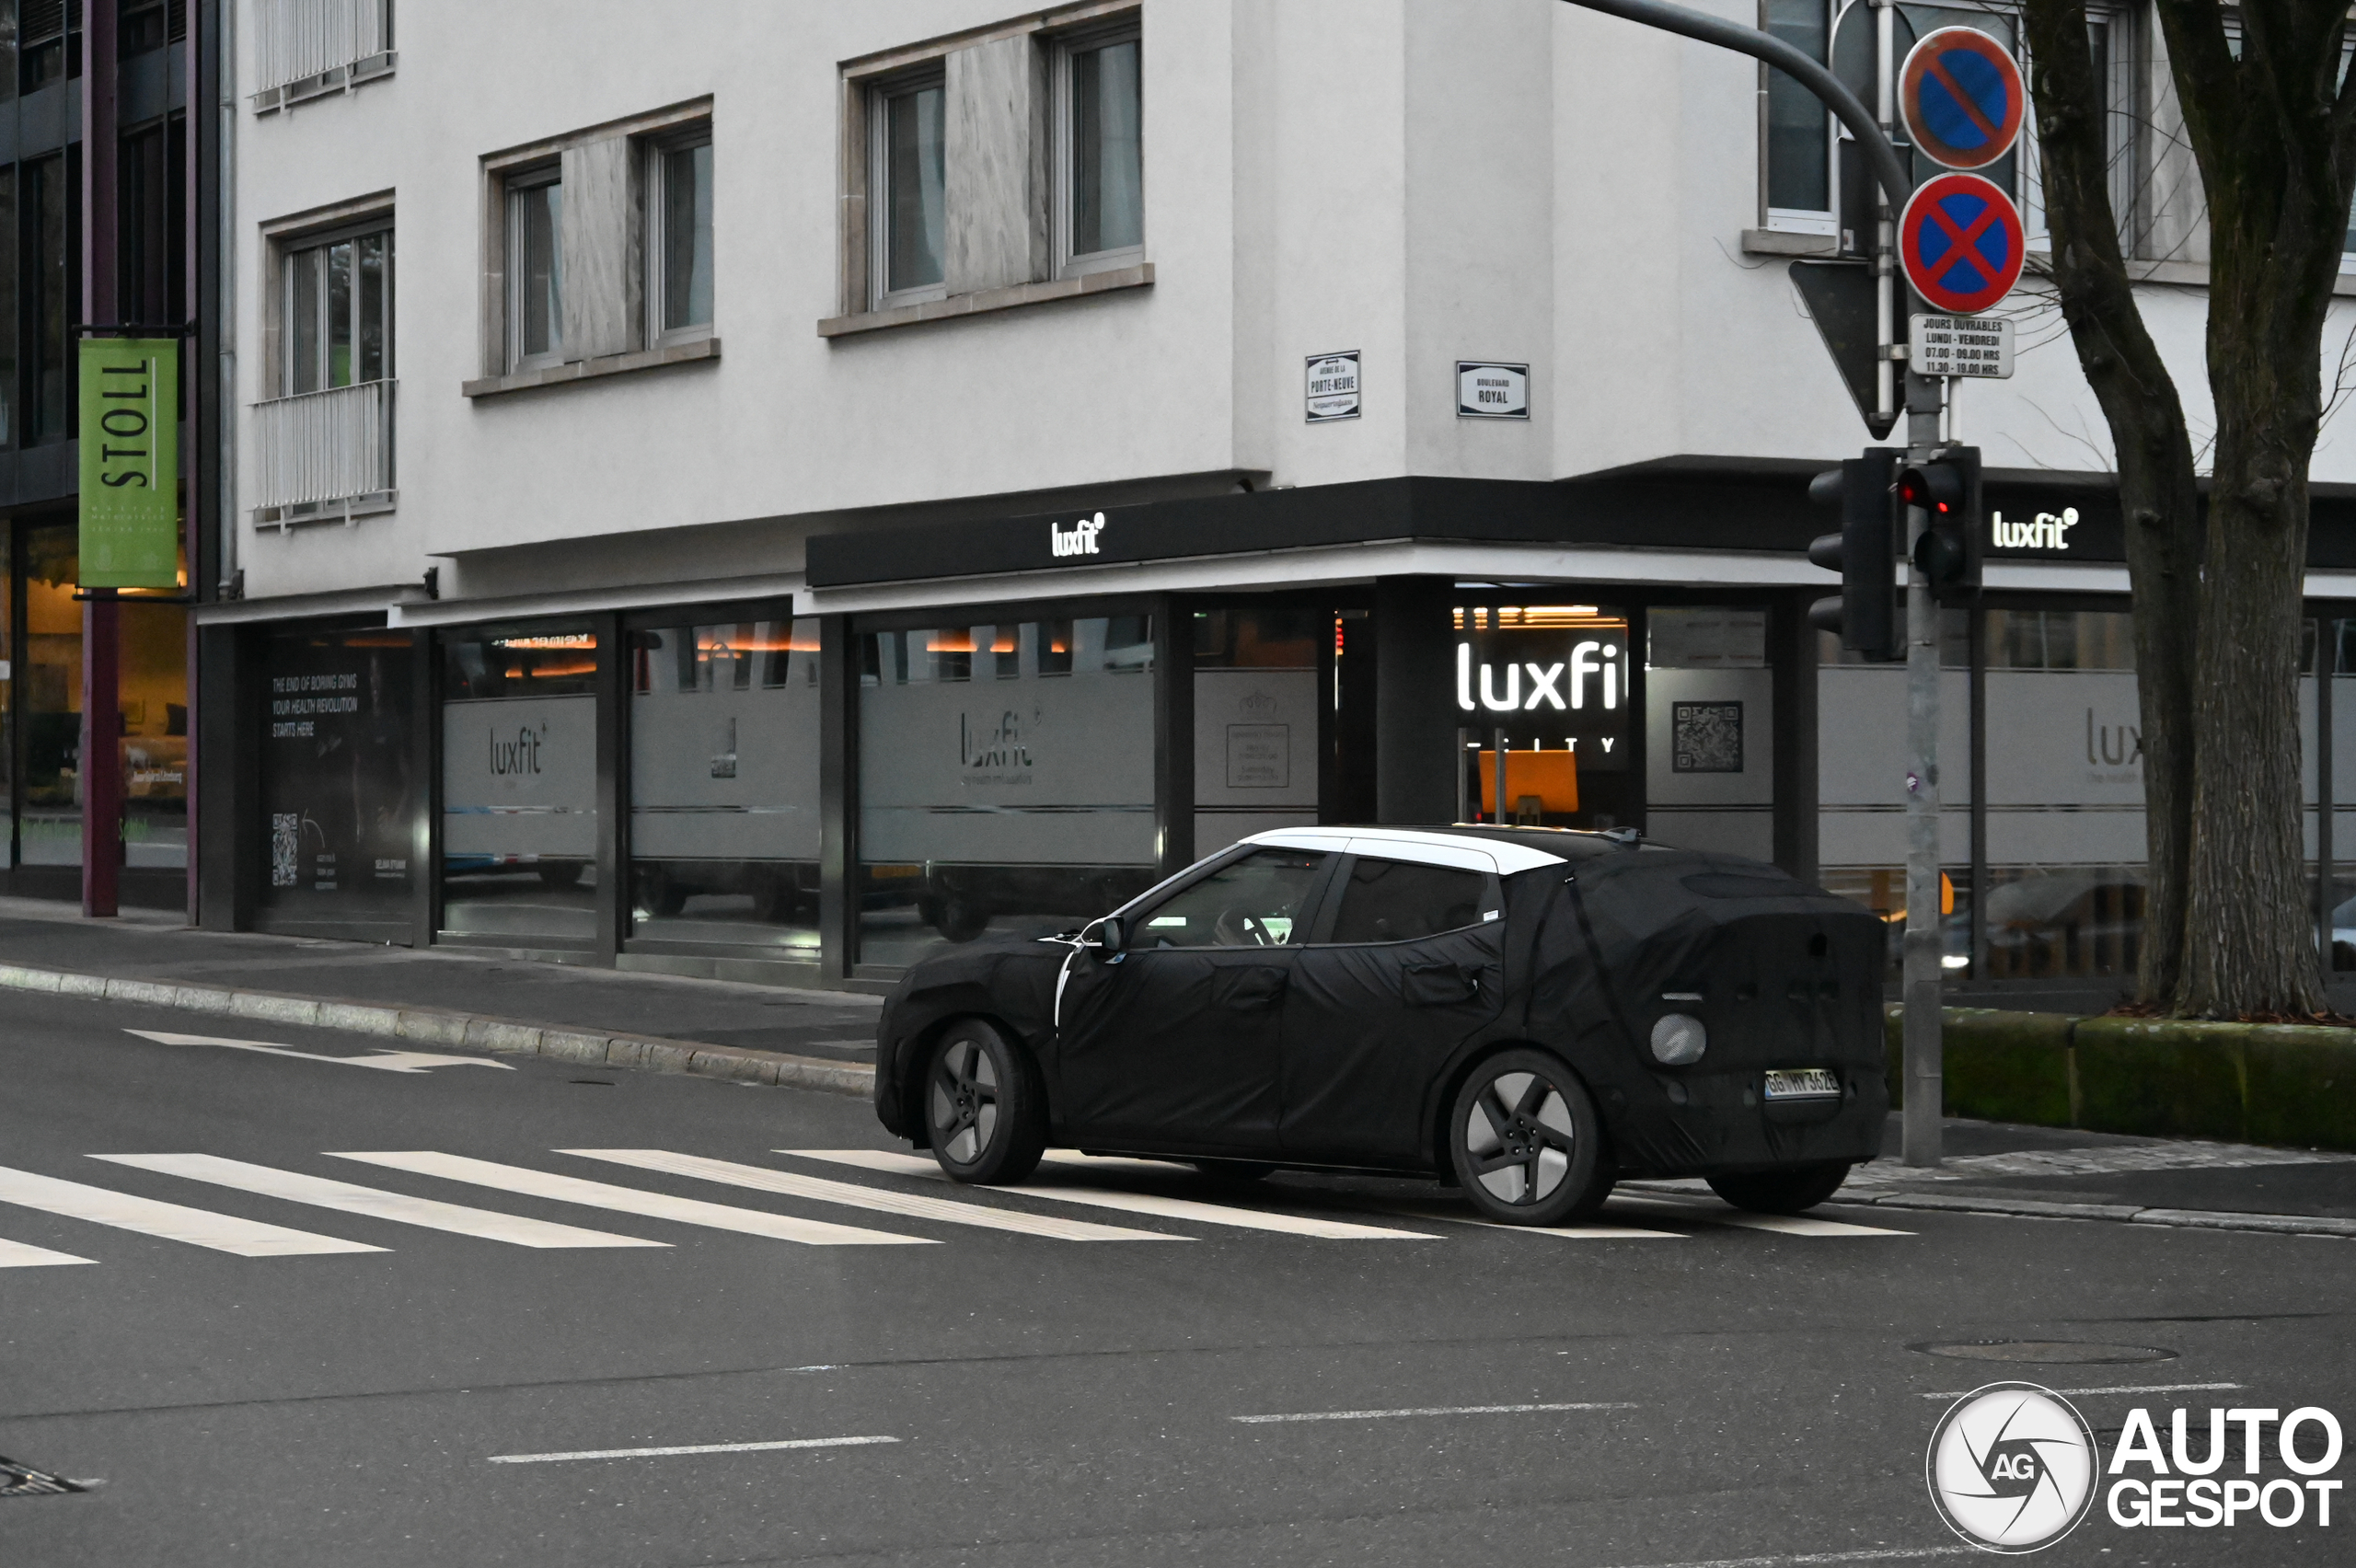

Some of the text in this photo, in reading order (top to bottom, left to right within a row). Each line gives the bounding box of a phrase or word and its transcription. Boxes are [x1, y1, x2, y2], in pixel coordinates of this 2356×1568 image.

[1923, 318, 2003, 331] JOURS OUVRABLES
[1926, 332, 1952, 344] LUNDI
[1958, 334, 2000, 346] VENDREDI
[1925, 347, 1949, 359] 07.00
[1957, 349, 1981, 360] 09.00
[1983, 350, 2000, 361] HRS
[1926, 362, 1949, 373] 11.30
[1957, 363, 1980, 375] 19.00
[1982, 364, 1999, 375] HRS
[1311, 376, 1354, 393] PORTE-NEUVE
[1477, 378, 1509, 387] BOULEVARD
[1479, 390, 1508, 404] ROYAL
[101, 360, 147, 488] STOLL
[1052, 516, 1101, 557] luxfit
[1992, 509, 2071, 549] luxfit
[272, 674, 357, 692] THE END OF BORING GYMS
[1458, 640, 1628, 711] luxfi
[272, 697, 358, 715] YOUR HEALTH REVOLUTION
[272, 721, 315, 737] STARTS HERE
[2087, 707, 2142, 766] lux
[491, 726, 541, 775] luxfit
[1766, 1071, 1839, 1093] GG HY 362E
